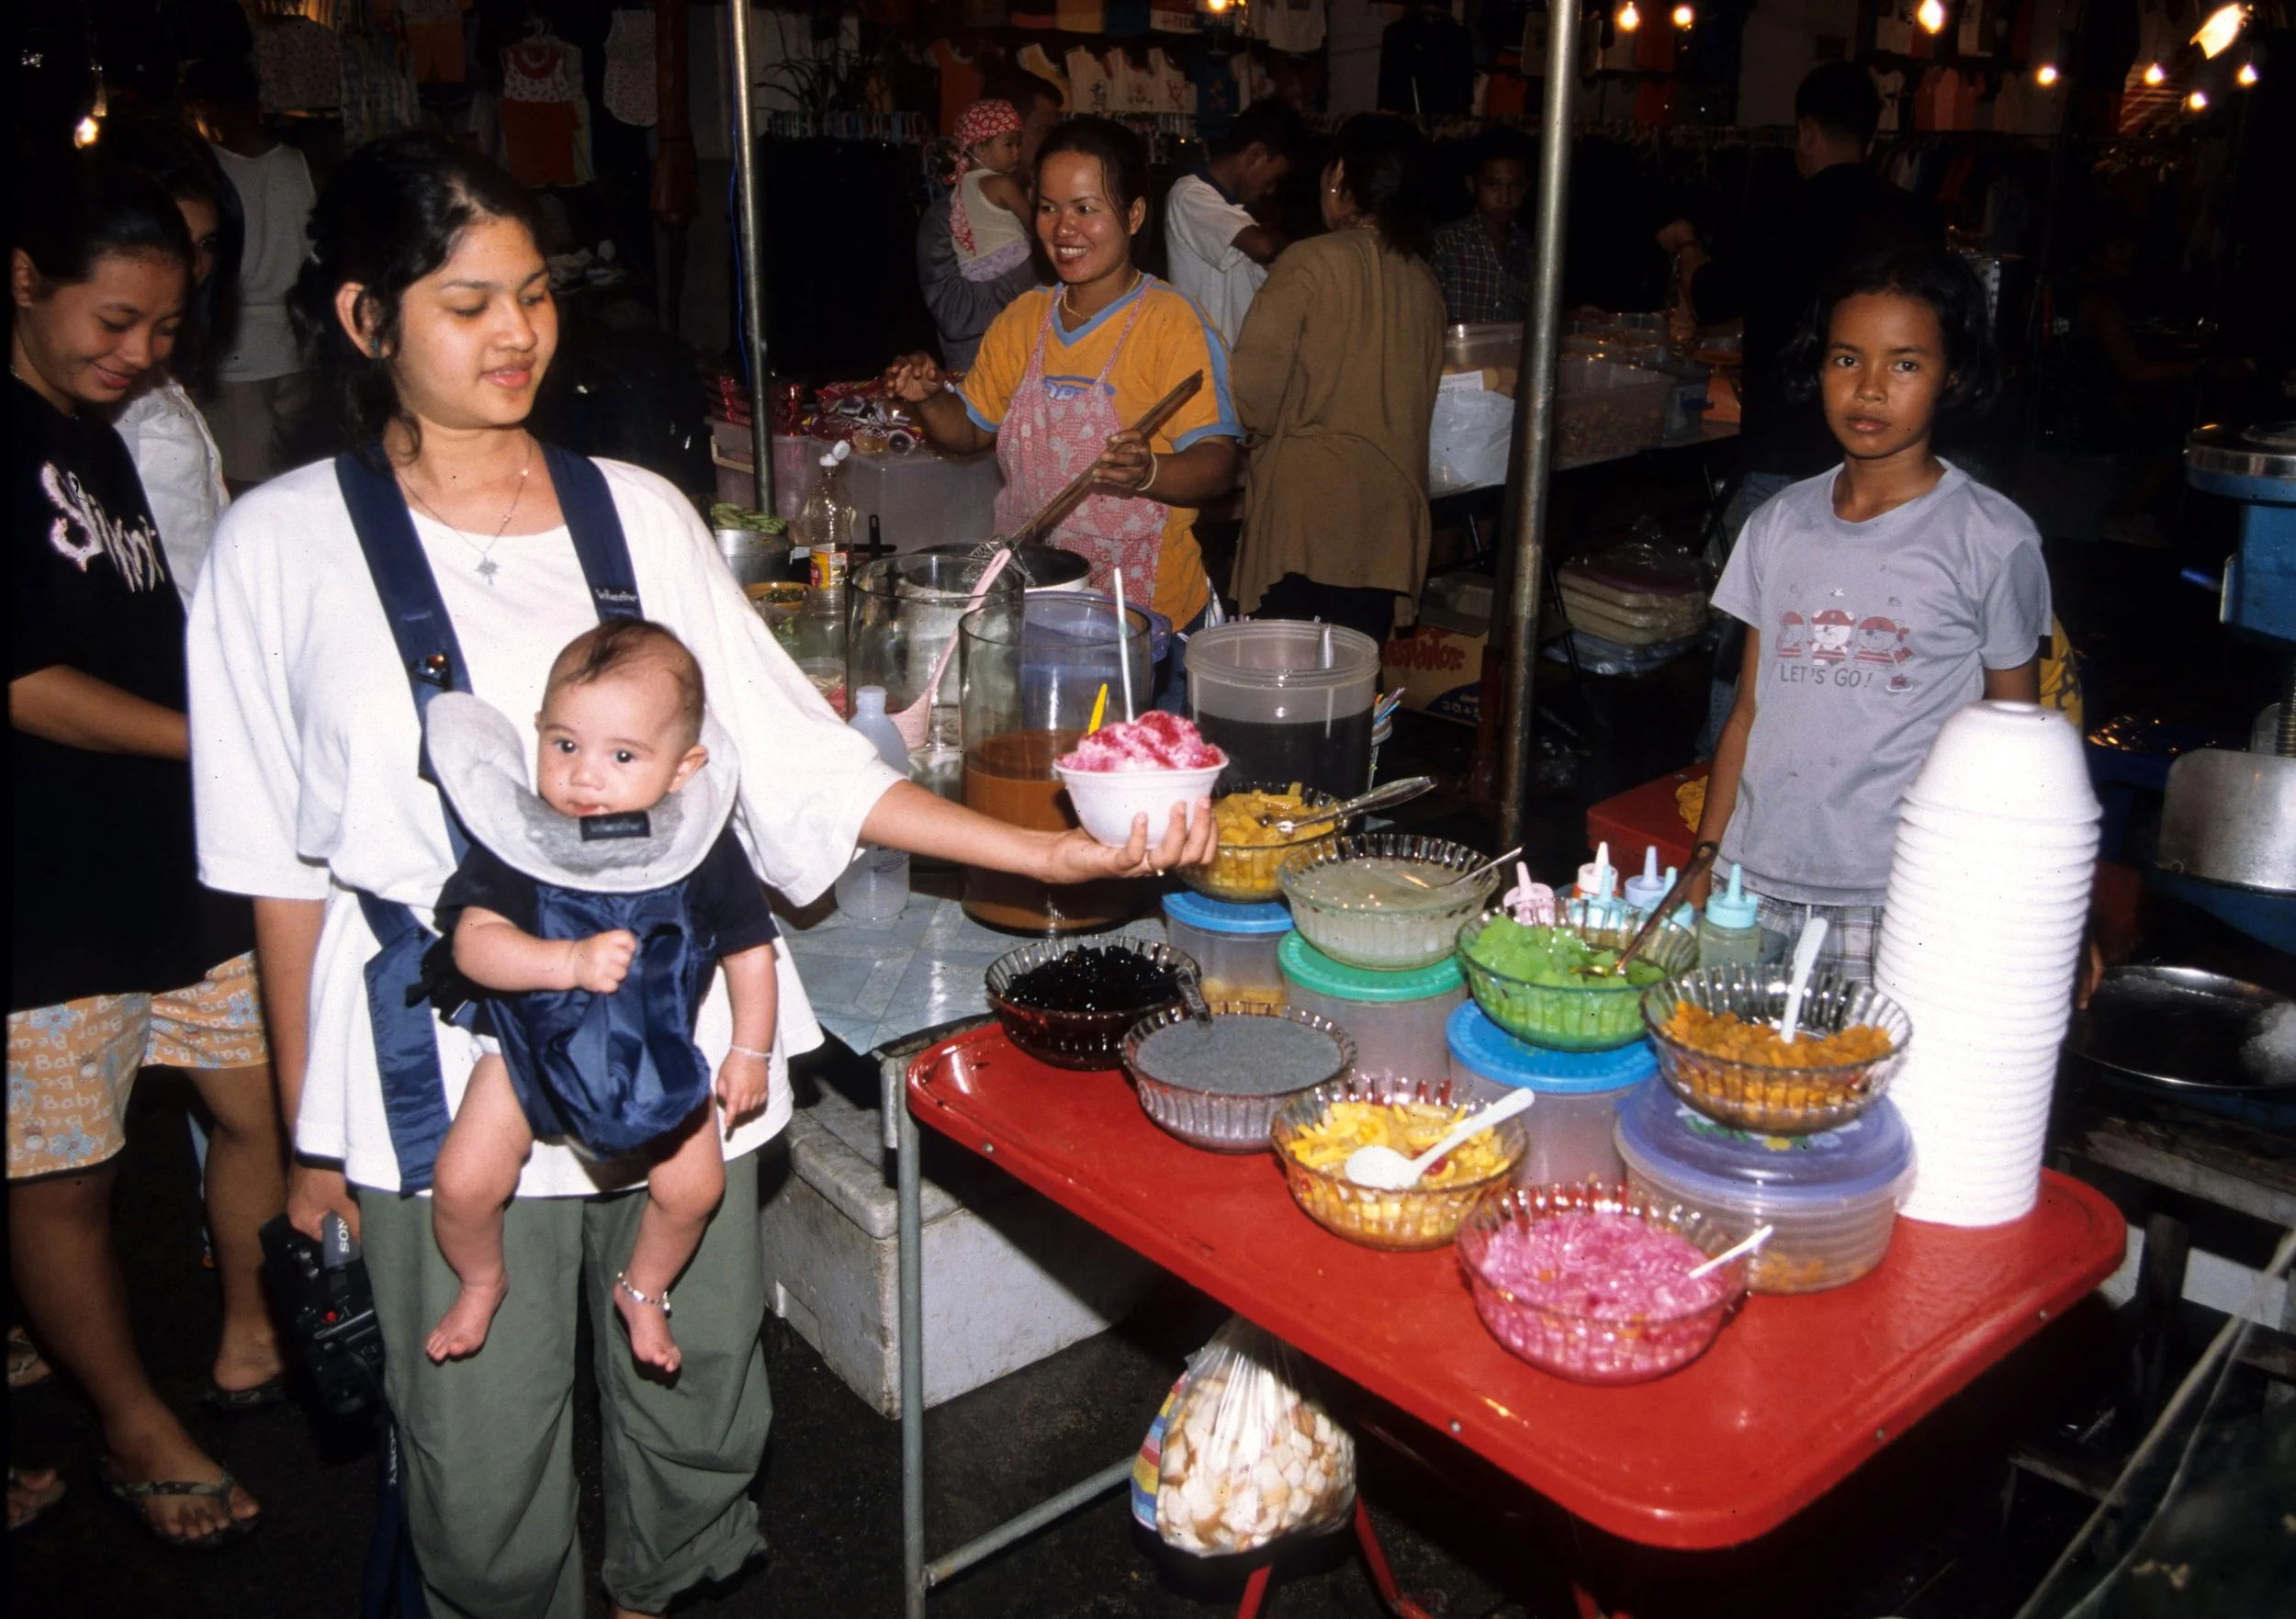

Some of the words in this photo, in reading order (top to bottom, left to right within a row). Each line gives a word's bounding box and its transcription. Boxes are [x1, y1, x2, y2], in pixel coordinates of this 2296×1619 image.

[1780, 664, 1827, 685] LET'S
[42, 1091, 103, 1110] Baby
[337, 1215, 350, 1254] SON
